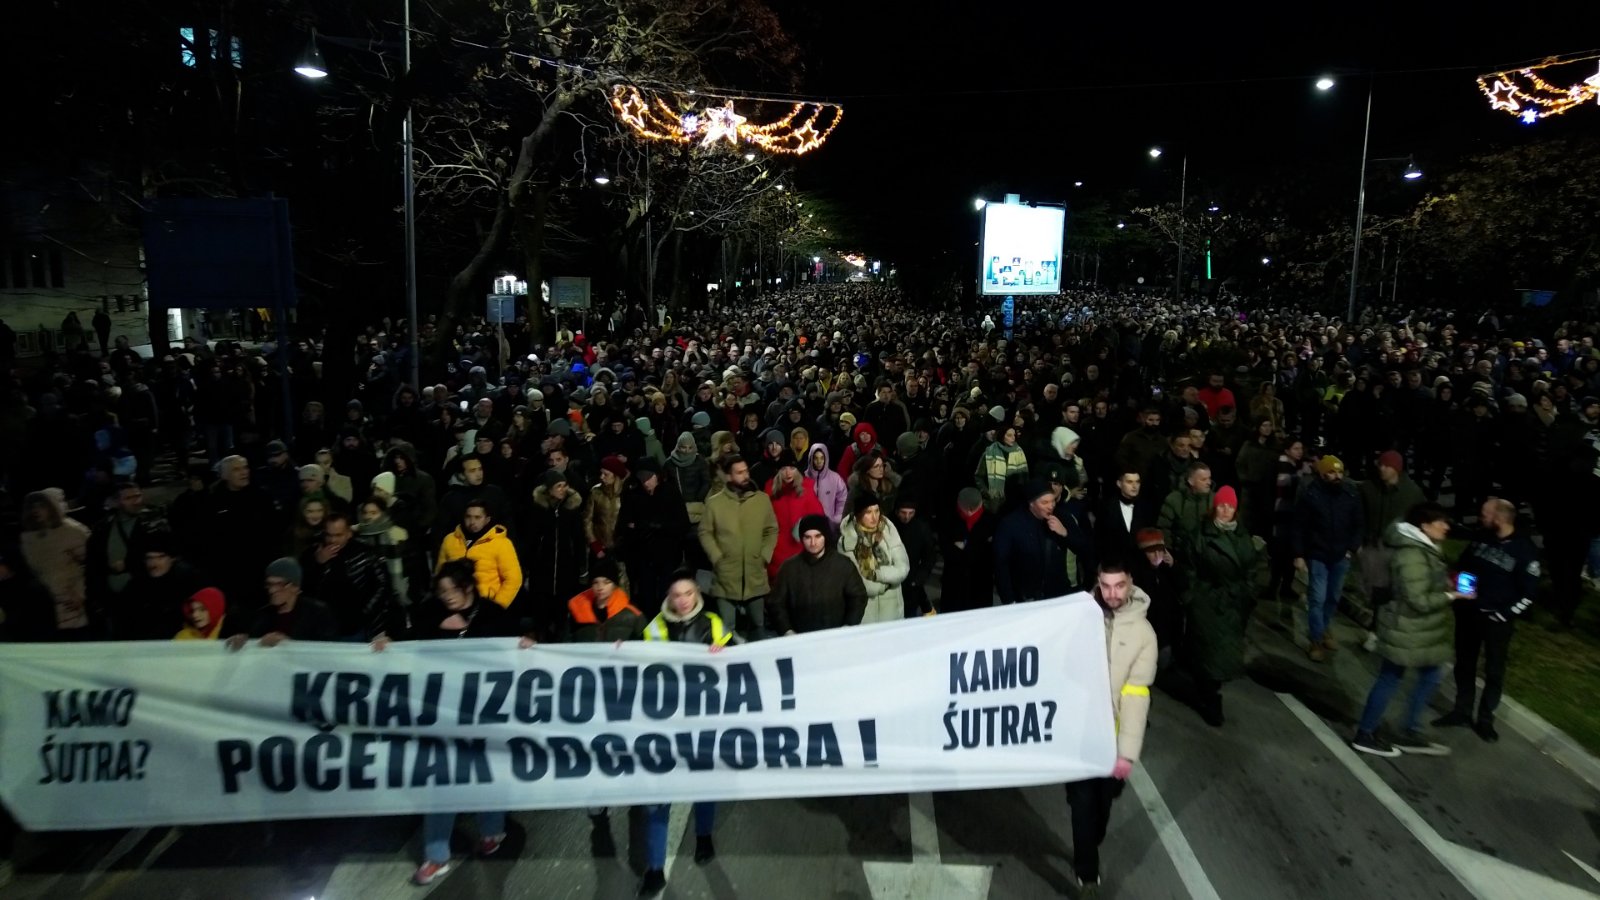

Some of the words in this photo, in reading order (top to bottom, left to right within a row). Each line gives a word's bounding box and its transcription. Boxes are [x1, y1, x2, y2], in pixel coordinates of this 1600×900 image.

[291, 672, 444, 727] KRAJ
[457, 662, 764, 725] IZGOVORA
[775, 656, 796, 711] !
[949, 646, 1040, 694] KAMO
[44, 688, 138, 730] KAMO
[943, 701, 1058, 751] ŚUTRA?
[39, 736, 150, 784] ŚUTRA?
[217, 725, 493, 794] POČETAK
[506, 722, 843, 781] ODGOVORA
[857, 717, 879, 769] !
